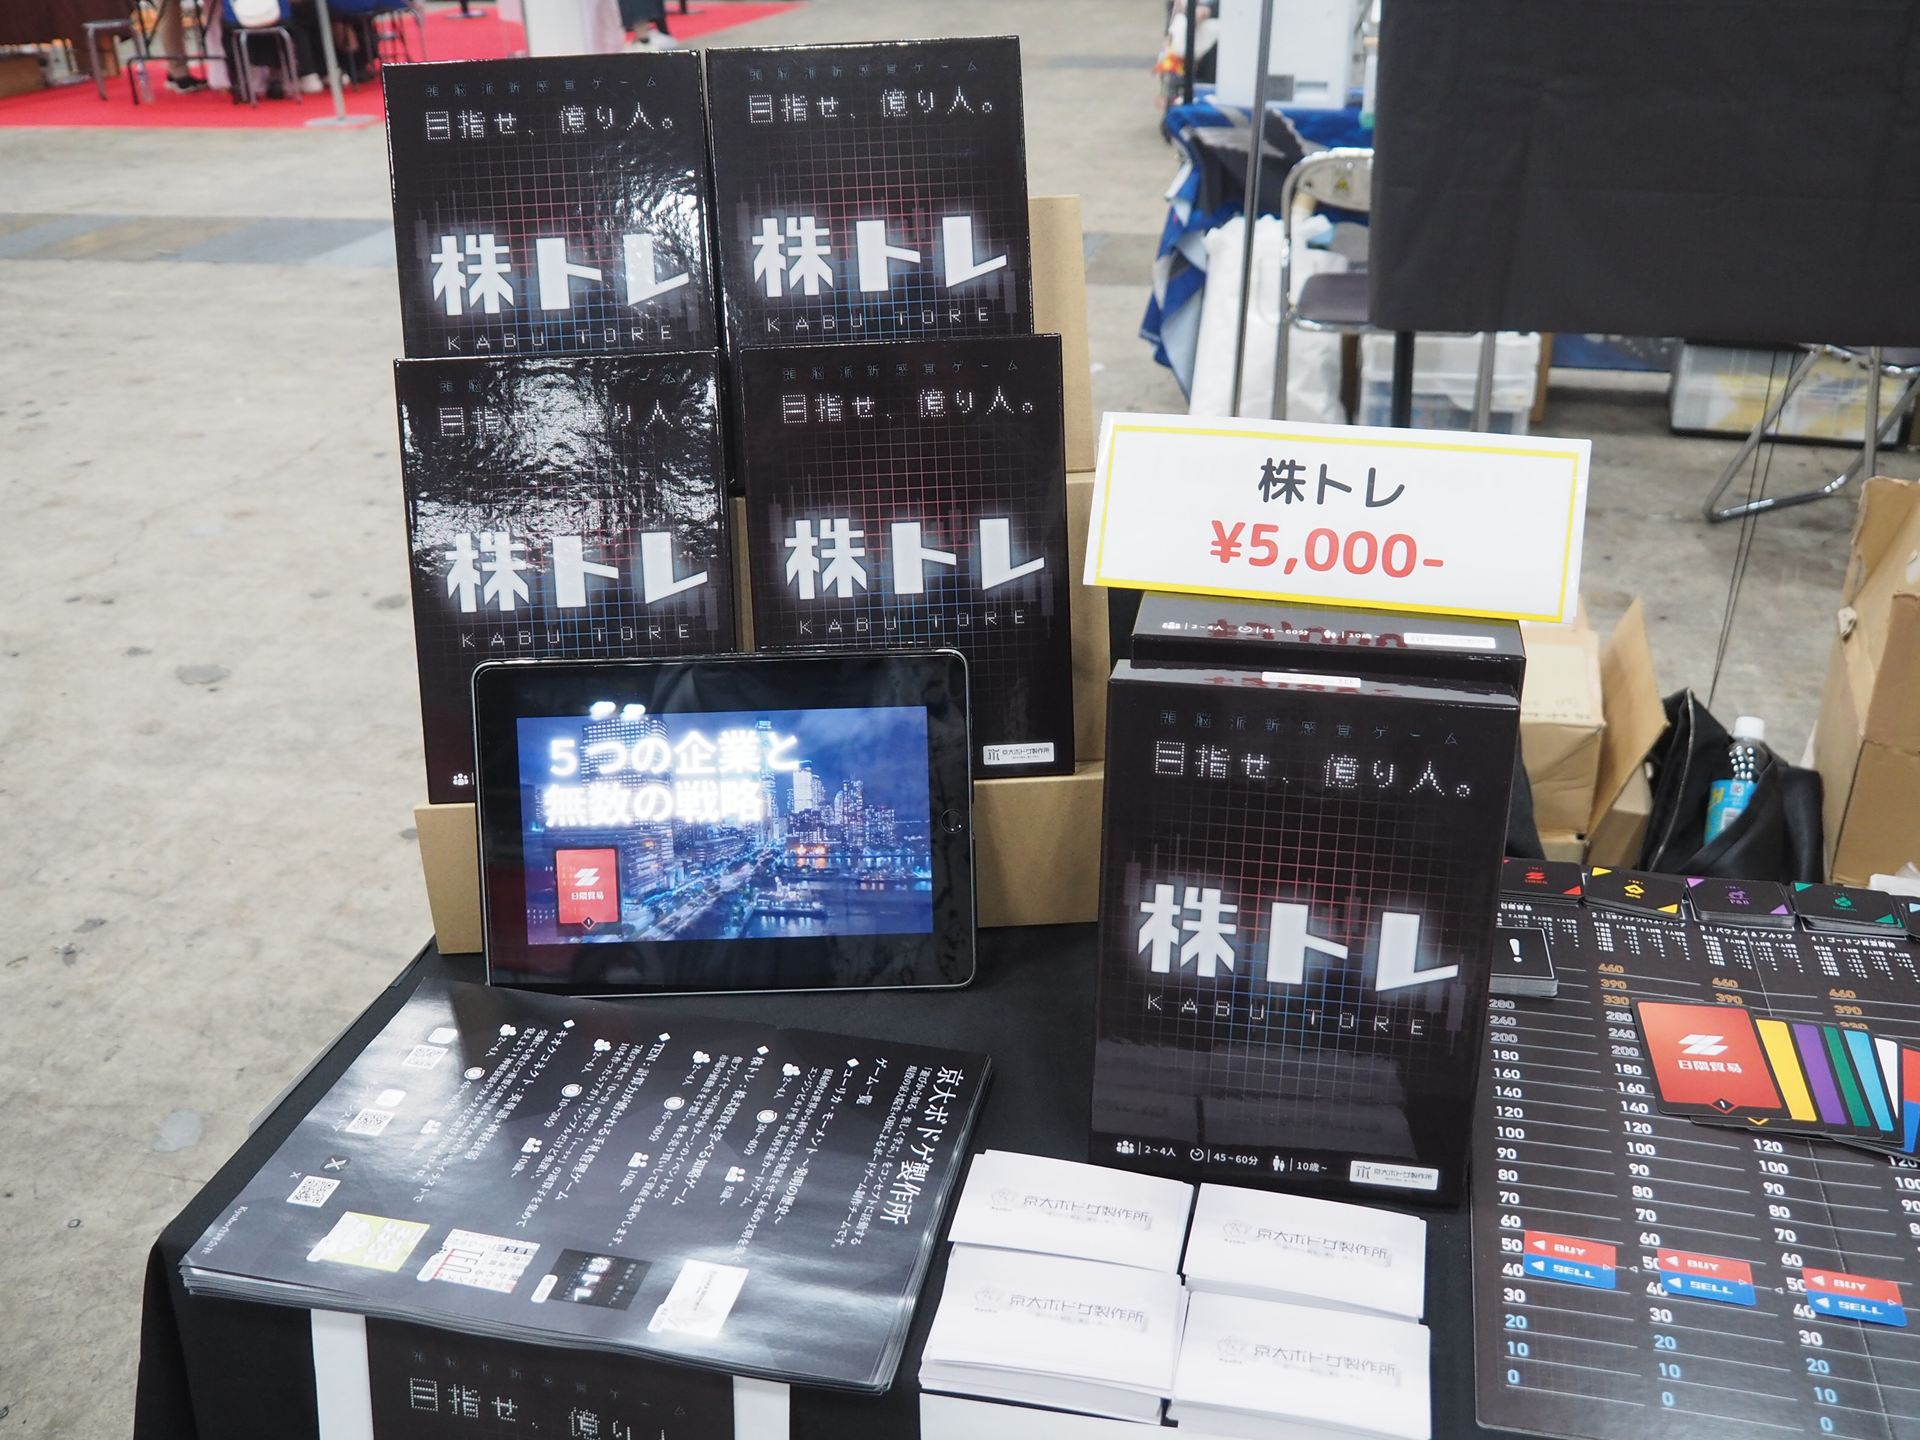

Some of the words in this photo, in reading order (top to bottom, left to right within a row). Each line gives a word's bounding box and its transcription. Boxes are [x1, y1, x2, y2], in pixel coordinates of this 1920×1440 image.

[749, 86, 992, 124] 目指せ、億り人。
[425, 102, 672, 140] 目指せ、億り人。
[752, 216, 1007, 298] 株トレ
[431, 234, 690, 316] 株トレ
[767, 313, 863, 332] KABU
[895, 307, 989, 326] TORE
[448, 332, 544, 350] KABU
[575, 325, 672, 344] TORE
[782, 386, 1033, 424] 目指せ、億り人。
[1258, 457, 1405, 508] 株トレ
[1209, 520, 1444, 578] ¥5,000-
[784, 518, 1045, 600] 株トレ
[445, 532, 708, 613] 株トレ
[800, 616, 897, 635] KABU
[931, 609, 1024, 628] TORE
[462, 629, 559, 648] KABU
[592, 624, 689, 642] TORE
[549, 730, 799, 776] 5つの企業と
[1155, 740, 1470, 797] 目指せ、億り人。
[544, 780, 763, 827] 無数の戦略
[1138, 883, 1458, 991] 株トレ
[1148, 994, 1264, 1020] KABU
[1307, 1008, 1424, 1035] TORE
[1489, 1015, 1517, 1026] 240
[1605, 1011, 1632, 1022] 280
[1490, 1032, 1518, 1043] 200
[1608, 1027, 1636, 1040] 240
[1493, 1050, 1519, 1061] 180
[1611, 1045, 1639, 1057] 200
[1494, 1068, 1520, 1080] 160
[1615, 1063, 1642, 1075] 180
[855, 1057, 888, 1105] ゲーム一覧
[1618, 1082, 1645, 1094] 160
[1495, 1086, 1522, 1098] 140
[1496, 1106, 1523, 1118] 120
[1621, 1101, 1649, 1114] 140
[1497, 1126, 1525, 1139] 100
[1624, 1121, 1652, 1134] 120
[878, 1065, 966, 1226] 京大ボドゲ製作所
[1627, 1142, 1656, 1156] 100
[1753, 1139, 1783, 1153] 120
[1497, 1147, 1517, 1160] 90
[1629, 1163, 1650, 1176] 90
[1758, 1160, 1789, 1174] 100
[1498, 1169, 1518, 1183] 80
[1632, 1185, 1653, 1200] 80
[1763, 1182, 1785, 1196] 90
[1499, 1191, 1520, 1206] 70
[1635, 1208, 1657, 1223] 70
[1769, 1205, 1791, 1219] 80
[1500, 1214, 1521, 1229] 60
[1639, 1231, 1661, 1246] 60
[1774, 1227, 1797, 1243] 70
[1501, 1238, 1523, 1253] 50
[1553, 1243, 1586, 1257] BUY
[1687, 1259, 1720, 1273] BUY
[1781, 1253, 1803, 1268] 60
[1502, 1262, 1524, 1277] 40
[1552, 1264, 1595, 1279] SELL
[1646, 1281, 1668, 1297] 40
[1690, 1281, 1734, 1296] SELL
[1833, 1279, 1867, 1291] BUY
[1503, 1288, 1525, 1303] 30
[1650, 1307, 1672, 1323] 30
[1793, 1303, 1816, 1319] 40
[1839, 1300, 1884, 1316] SELL
[1505, 1314, 1527, 1329] 20
[1654, 1334, 1676, 1351] 20
[1799, 1330, 1823, 1346] 30
[1507, 1341, 1529, 1357] 10
[1659, 1362, 1681, 1379] 10
[1806, 1358, 1830, 1374] 20
[1508, 1369, 1520, 1384] 0
[1662, 1391, 1674, 1407] 0
[1814, 1386, 1837, 1404] 10
[410, 1377, 665, 1440] 目指せ、億り
[1820, 1416, 1833, 1432] 0
